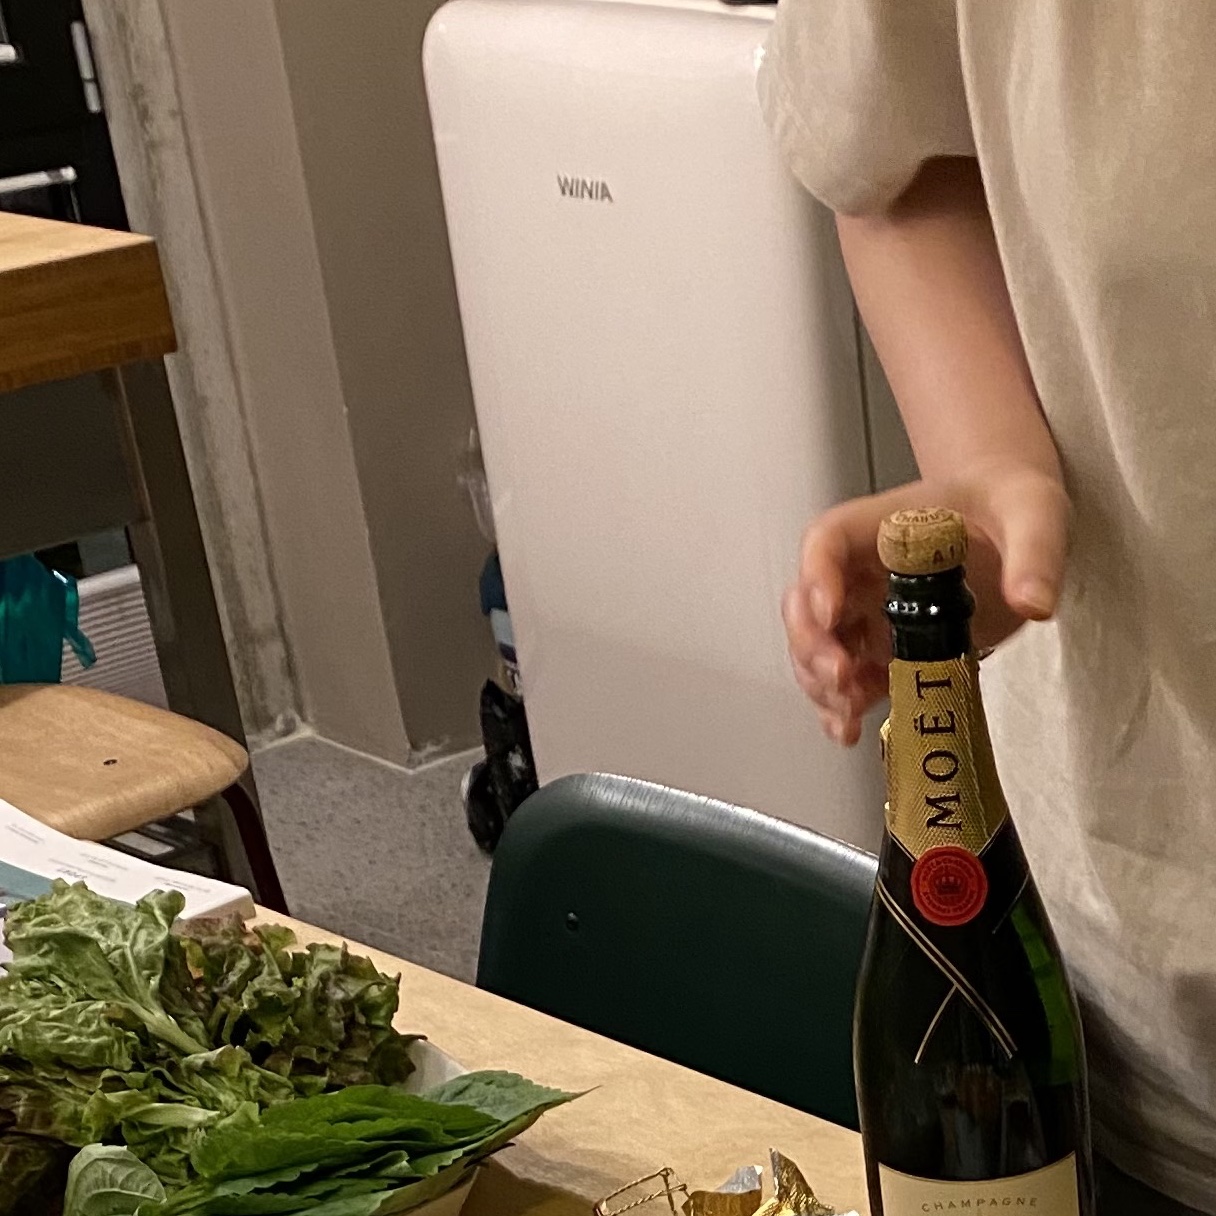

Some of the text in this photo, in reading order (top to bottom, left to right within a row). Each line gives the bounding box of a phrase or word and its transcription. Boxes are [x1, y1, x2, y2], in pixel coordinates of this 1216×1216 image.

[557, 174, 613, 203] WINIA
[914, 669, 963, 831] MOËT
[921, 1197, 1038, 1212] CHAMPAGNE
